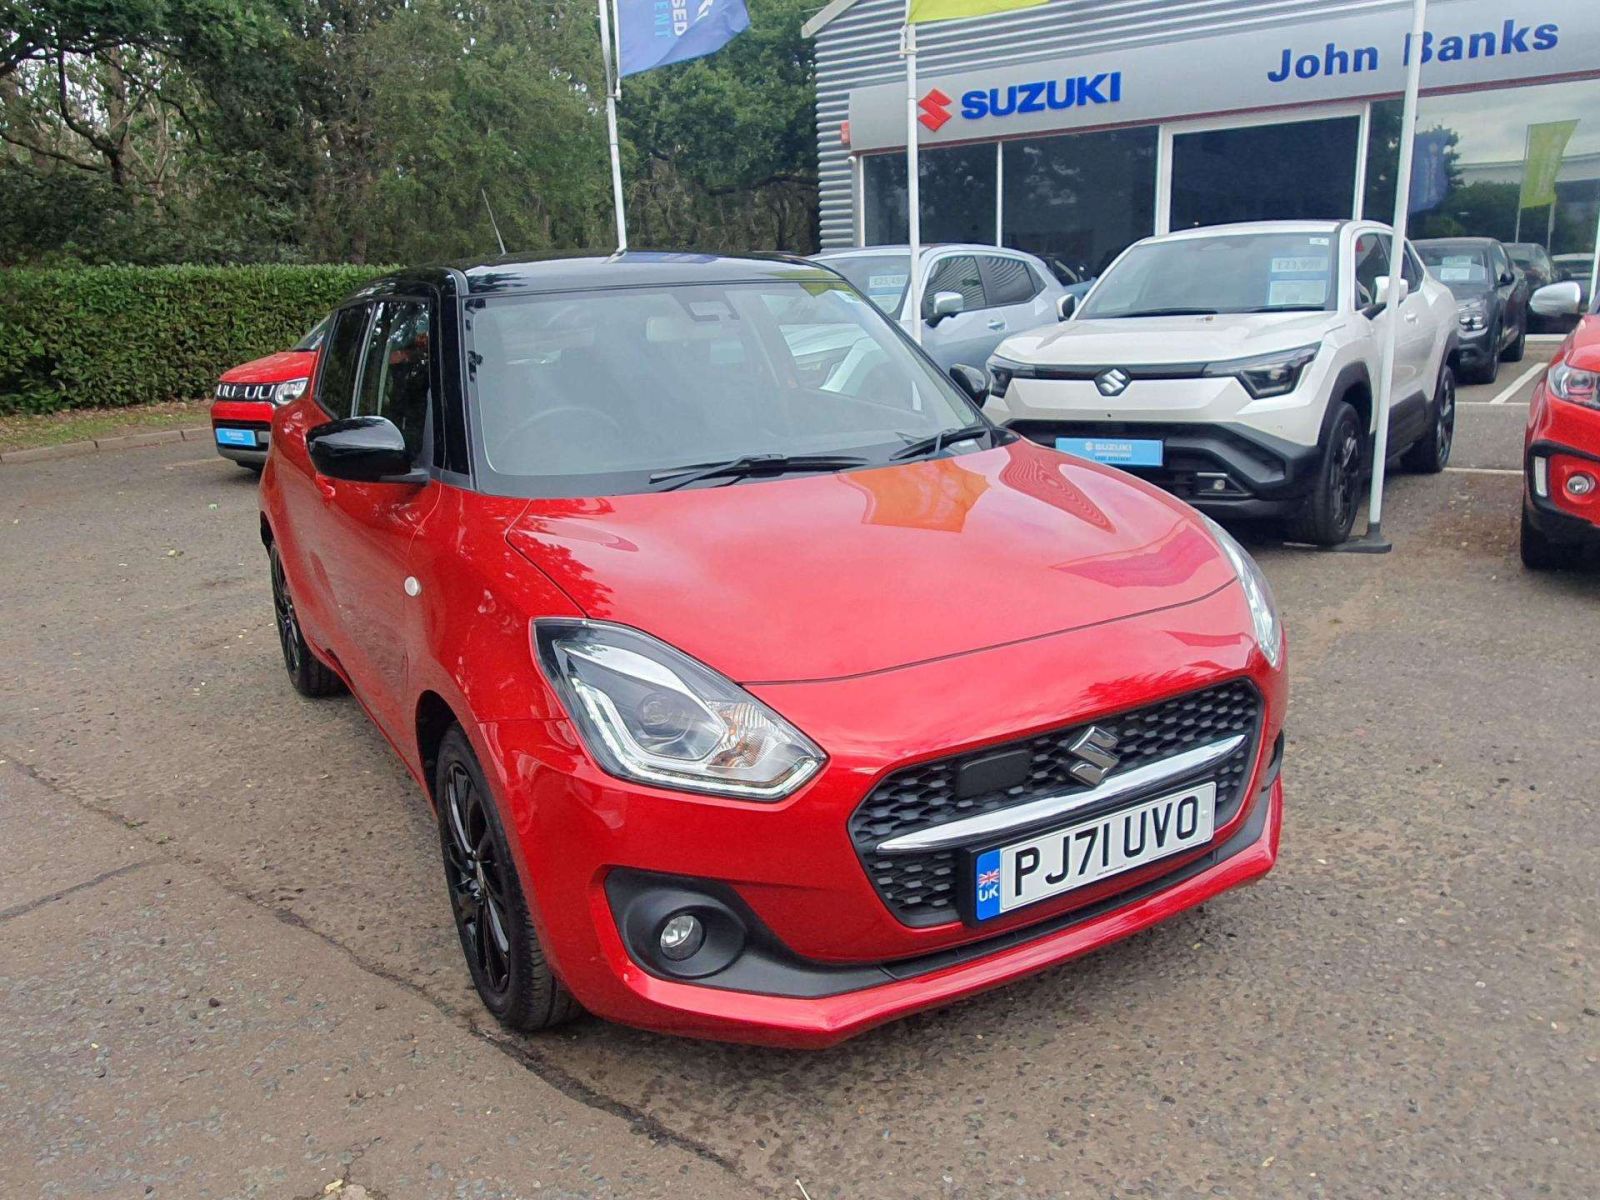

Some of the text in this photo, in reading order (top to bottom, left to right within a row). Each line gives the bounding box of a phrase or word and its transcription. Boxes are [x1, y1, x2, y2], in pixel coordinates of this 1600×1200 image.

[1267, 19, 1559, 83] John Banks
[961, 71, 1122, 120] SUZUKI
[1014, 795, 1199, 897] PJ71 UVO
[978, 884, 999, 902] UK
